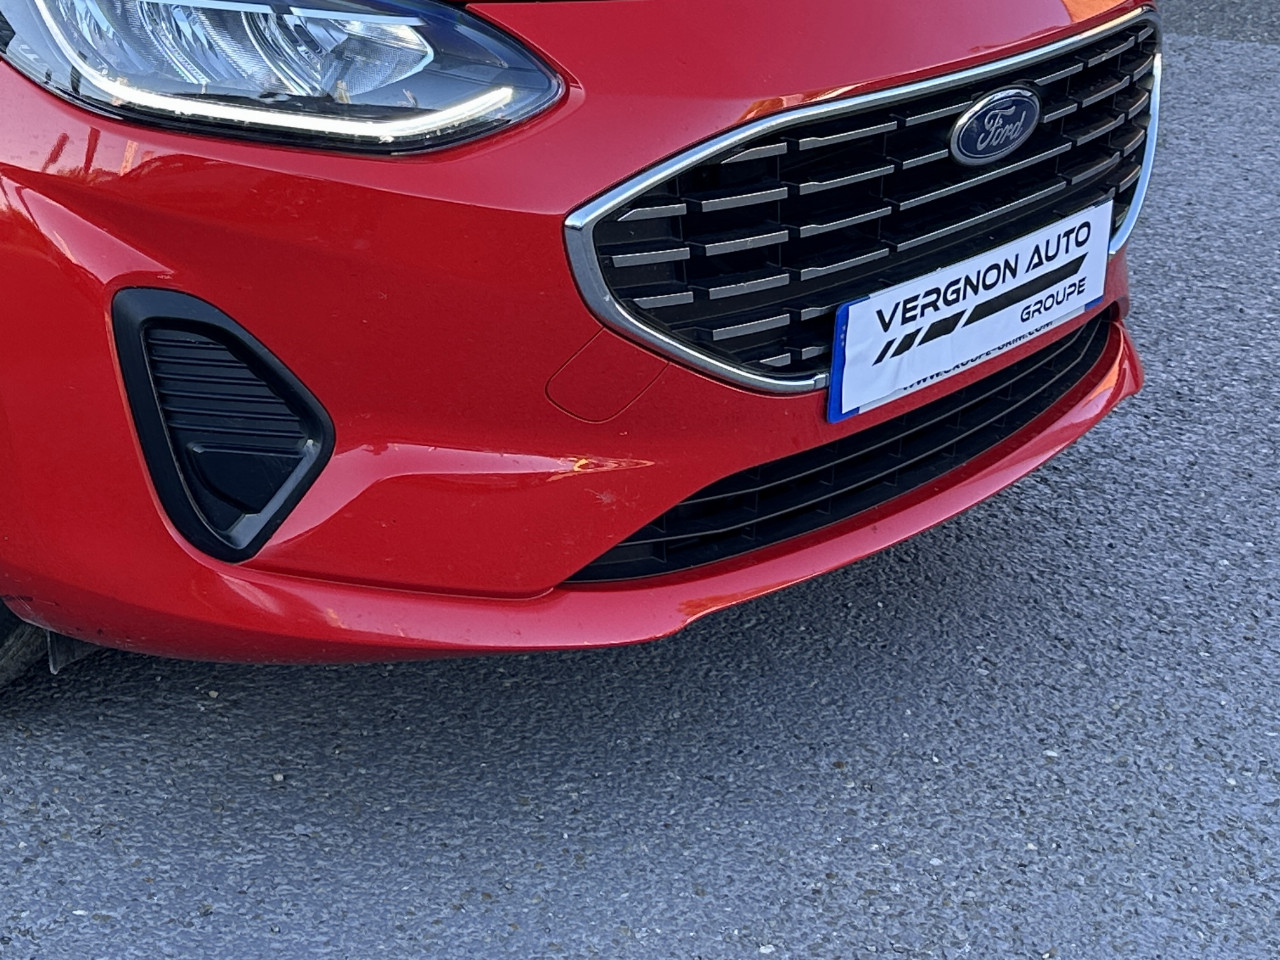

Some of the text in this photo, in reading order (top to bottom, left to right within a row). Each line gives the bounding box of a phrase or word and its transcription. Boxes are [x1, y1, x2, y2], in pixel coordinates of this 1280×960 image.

[976, 105, 1027, 151] Ford
[876, 221, 1091, 333] VERGNON AUTO
[1020, 276, 1088, 323] GROUPE
